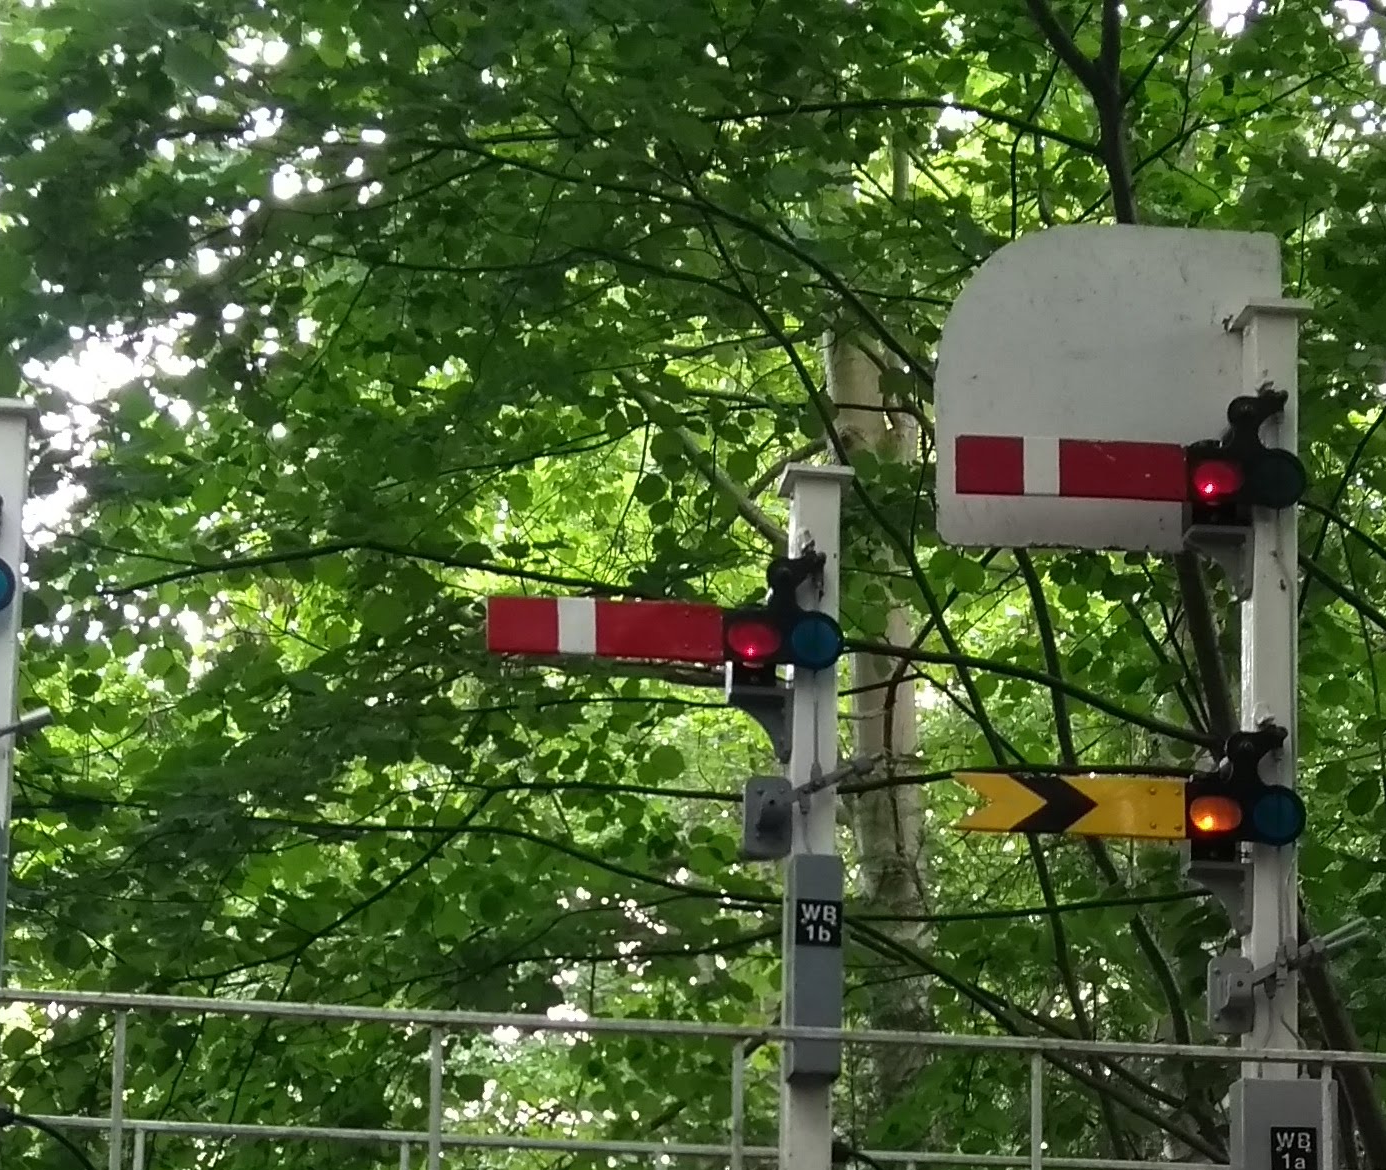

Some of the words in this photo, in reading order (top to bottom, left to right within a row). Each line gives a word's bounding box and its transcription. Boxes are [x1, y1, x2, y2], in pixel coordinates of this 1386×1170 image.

[801, 903, 837, 921] WB
[806, 924, 831, 943] 1b
[1276, 1131, 1311, 1150] WB
[1281, 1152, 1306, 1170] 1a
